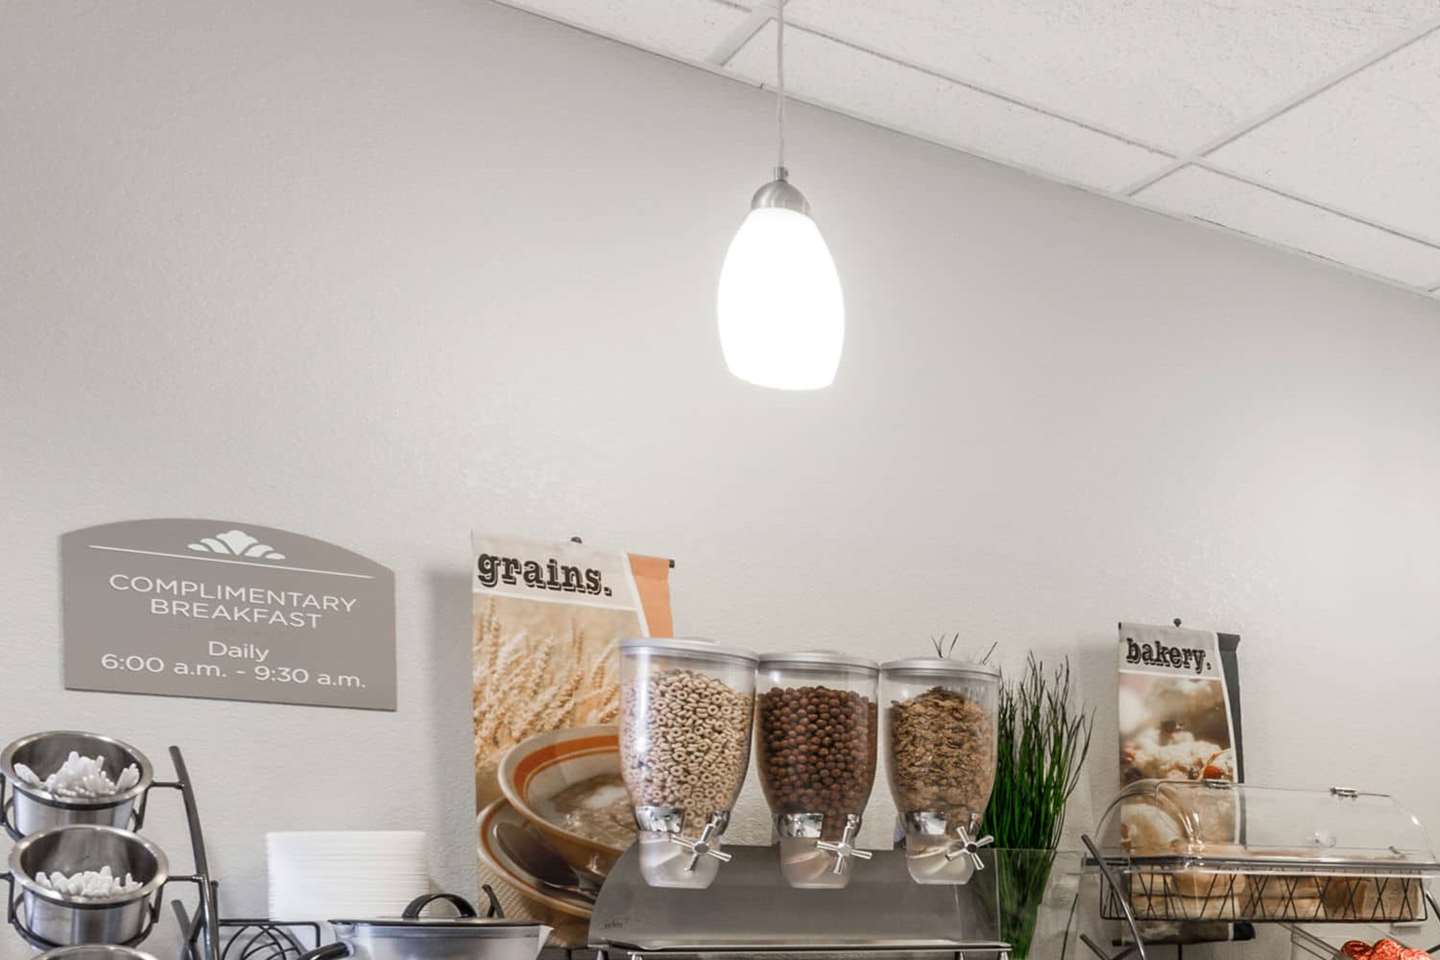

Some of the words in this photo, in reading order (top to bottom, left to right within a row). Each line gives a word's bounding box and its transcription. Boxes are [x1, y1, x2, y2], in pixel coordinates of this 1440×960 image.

[109, 573, 357, 613] COMPLIMENTARY
[477, 552, 613, 597] grains.
[150, 598, 323, 629] BREAKFAST
[208, 640, 270, 662] Daily
[1125, 636, 1212, 675] bakery.
[101, 653, 165, 673] 6:00
[173, 661, 227, 678] a.m.
[254, 665, 310, 685] 9:30
[317, 672, 366, 688] a.m.
